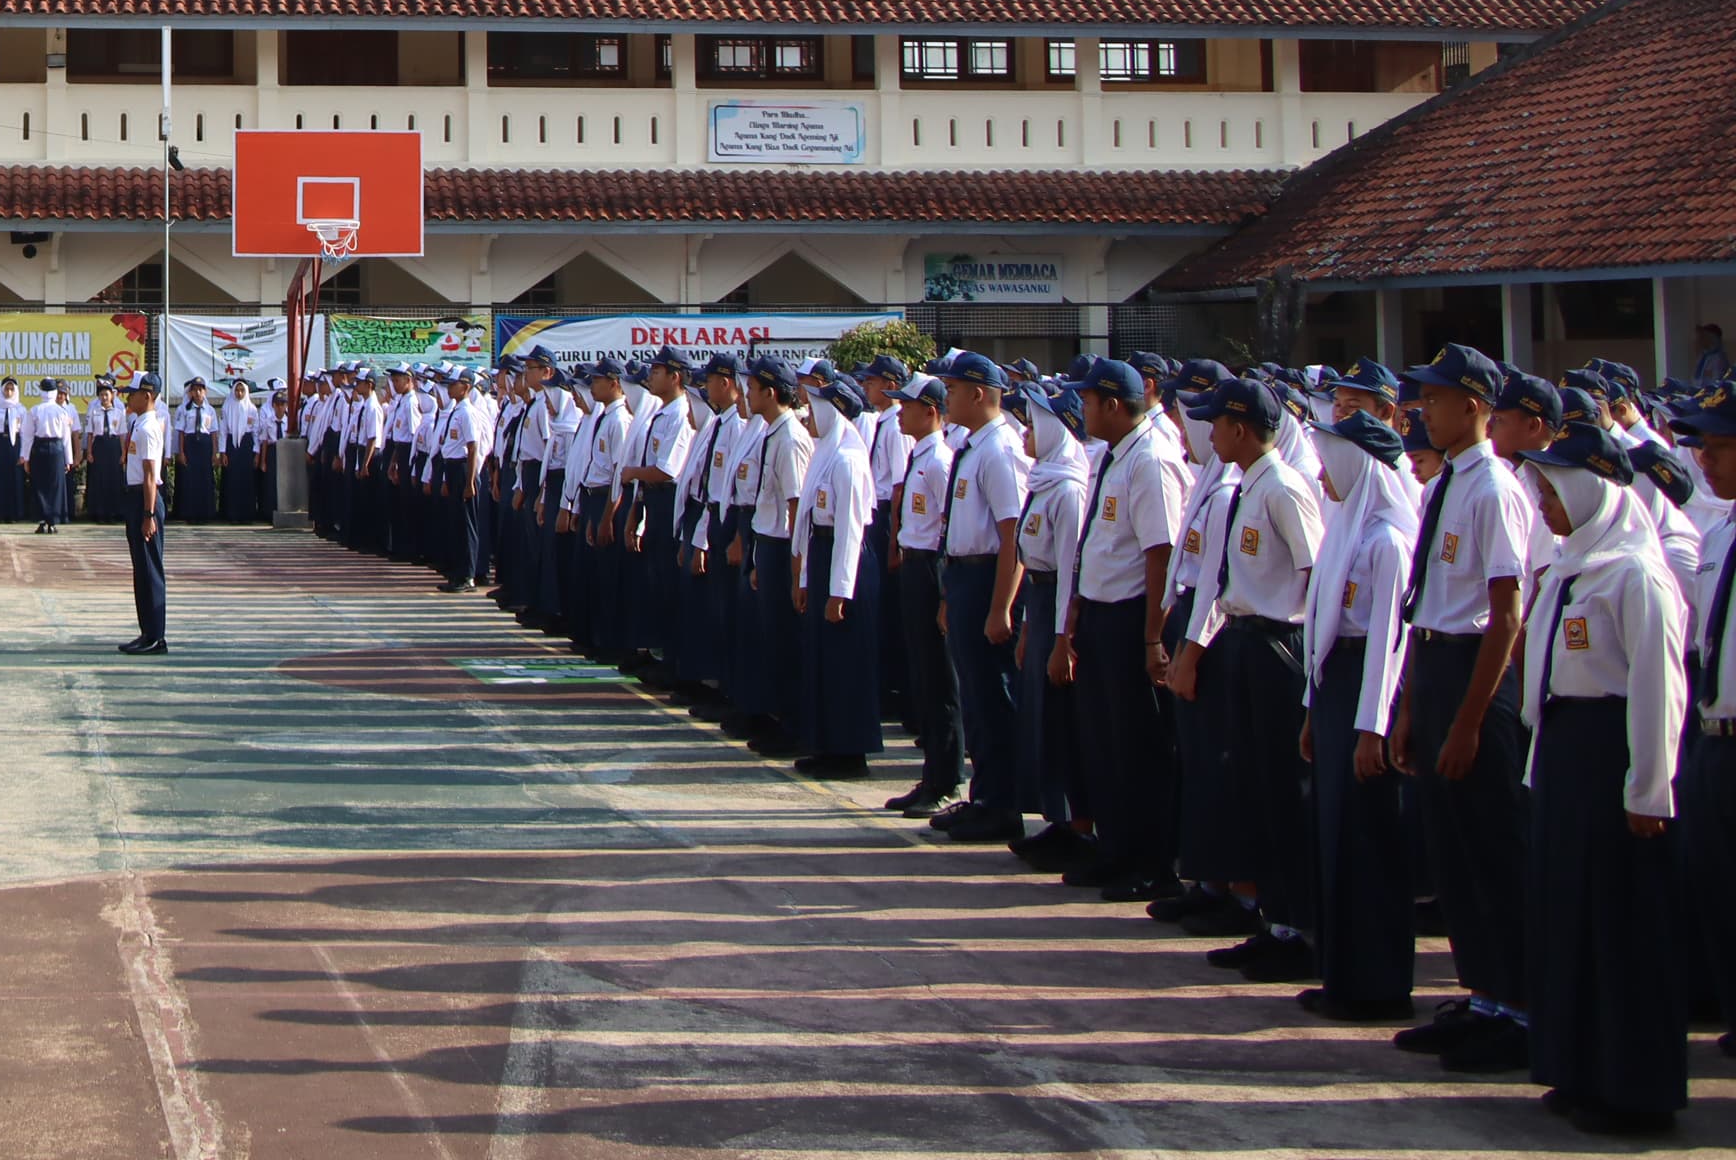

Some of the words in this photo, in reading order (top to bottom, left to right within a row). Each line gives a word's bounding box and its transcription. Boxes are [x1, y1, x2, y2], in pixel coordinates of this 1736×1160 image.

[953, 264, 996, 280] GEMAR
[998, 264, 1058, 281] MEMBACA
[988, 284, 1050, 293] WAWASANKU
[631, 327, 770, 346] DEKLARASI
[554, 350, 591, 362] GURU
[596, 351, 627, 361] DAN
[16, 363, 92, 376] BANJARNEGARA
